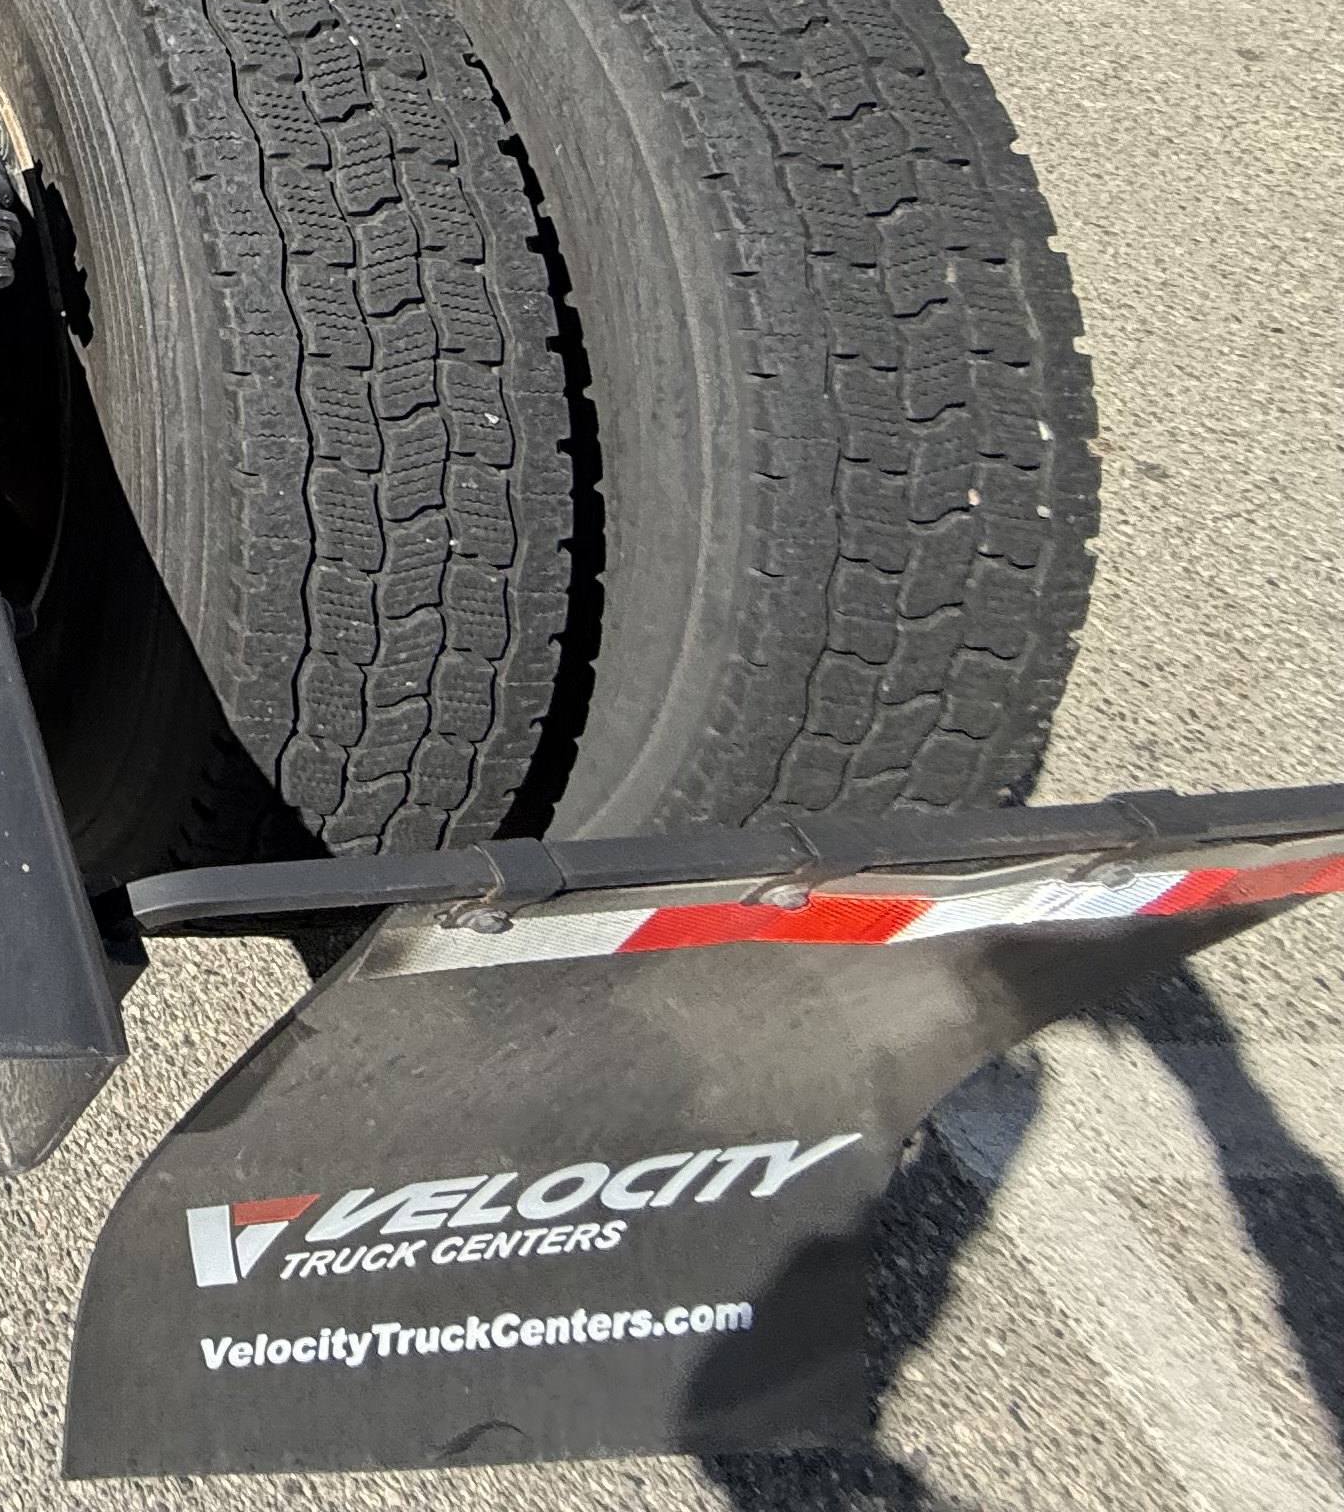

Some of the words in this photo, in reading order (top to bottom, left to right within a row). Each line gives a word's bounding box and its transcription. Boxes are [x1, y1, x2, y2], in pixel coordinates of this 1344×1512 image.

[304, 1132, 864, 1243] VELOCITY
[279, 1244, 429, 1281] TRUCK
[431, 1219, 629, 1266] CENTERS
[200, 1300, 753, 1371] VelocityTruckCenters.com
